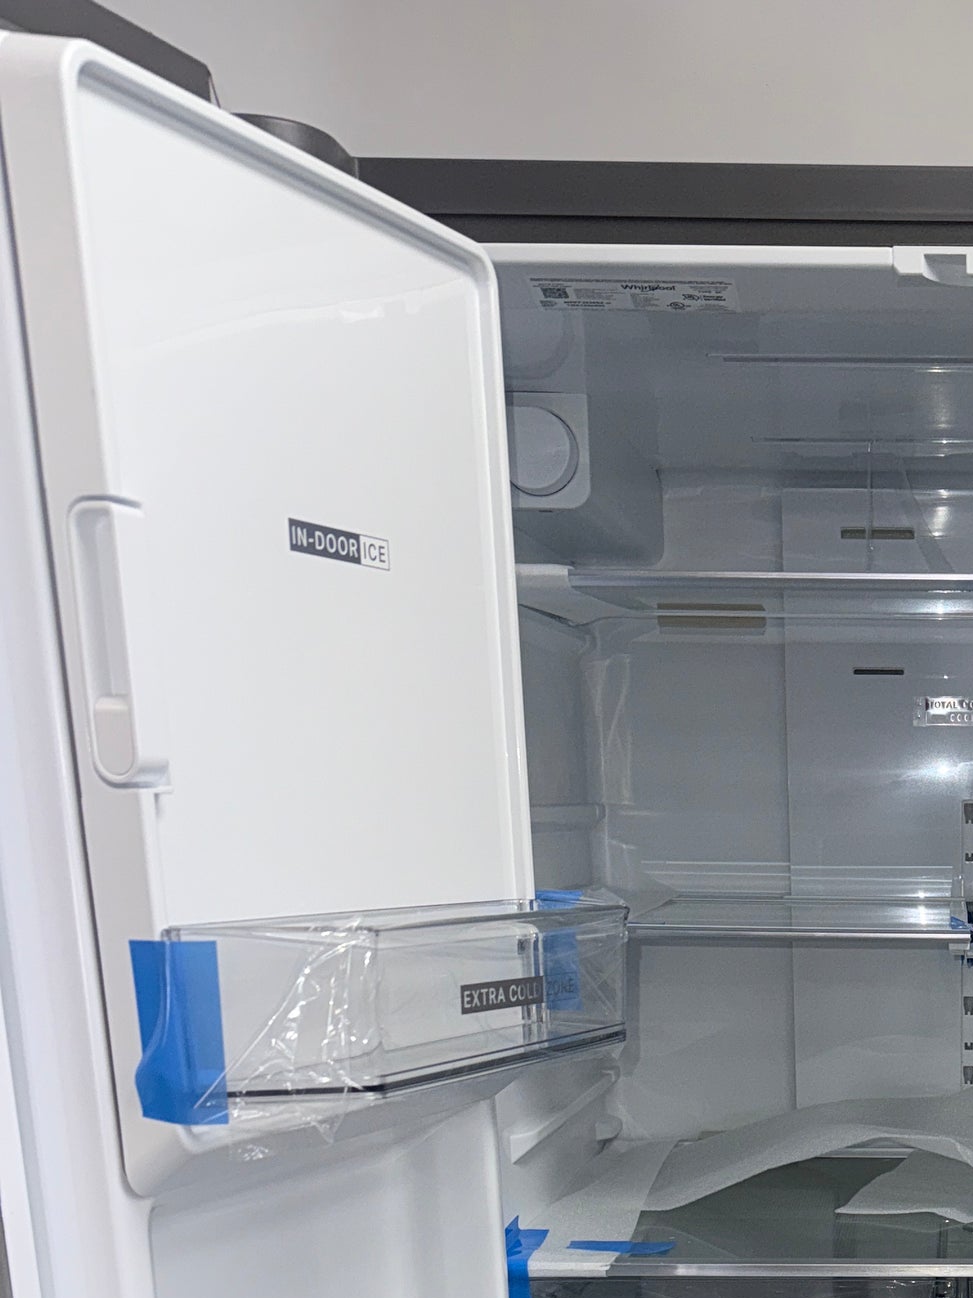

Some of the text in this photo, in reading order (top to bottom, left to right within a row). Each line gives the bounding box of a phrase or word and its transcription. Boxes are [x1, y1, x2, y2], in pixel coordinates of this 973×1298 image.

[291, 525, 386, 563] IN-DOOR ICE
[927, 700, 959, 709] TOTAL
[463, 986, 506, 1009] EXTRA
